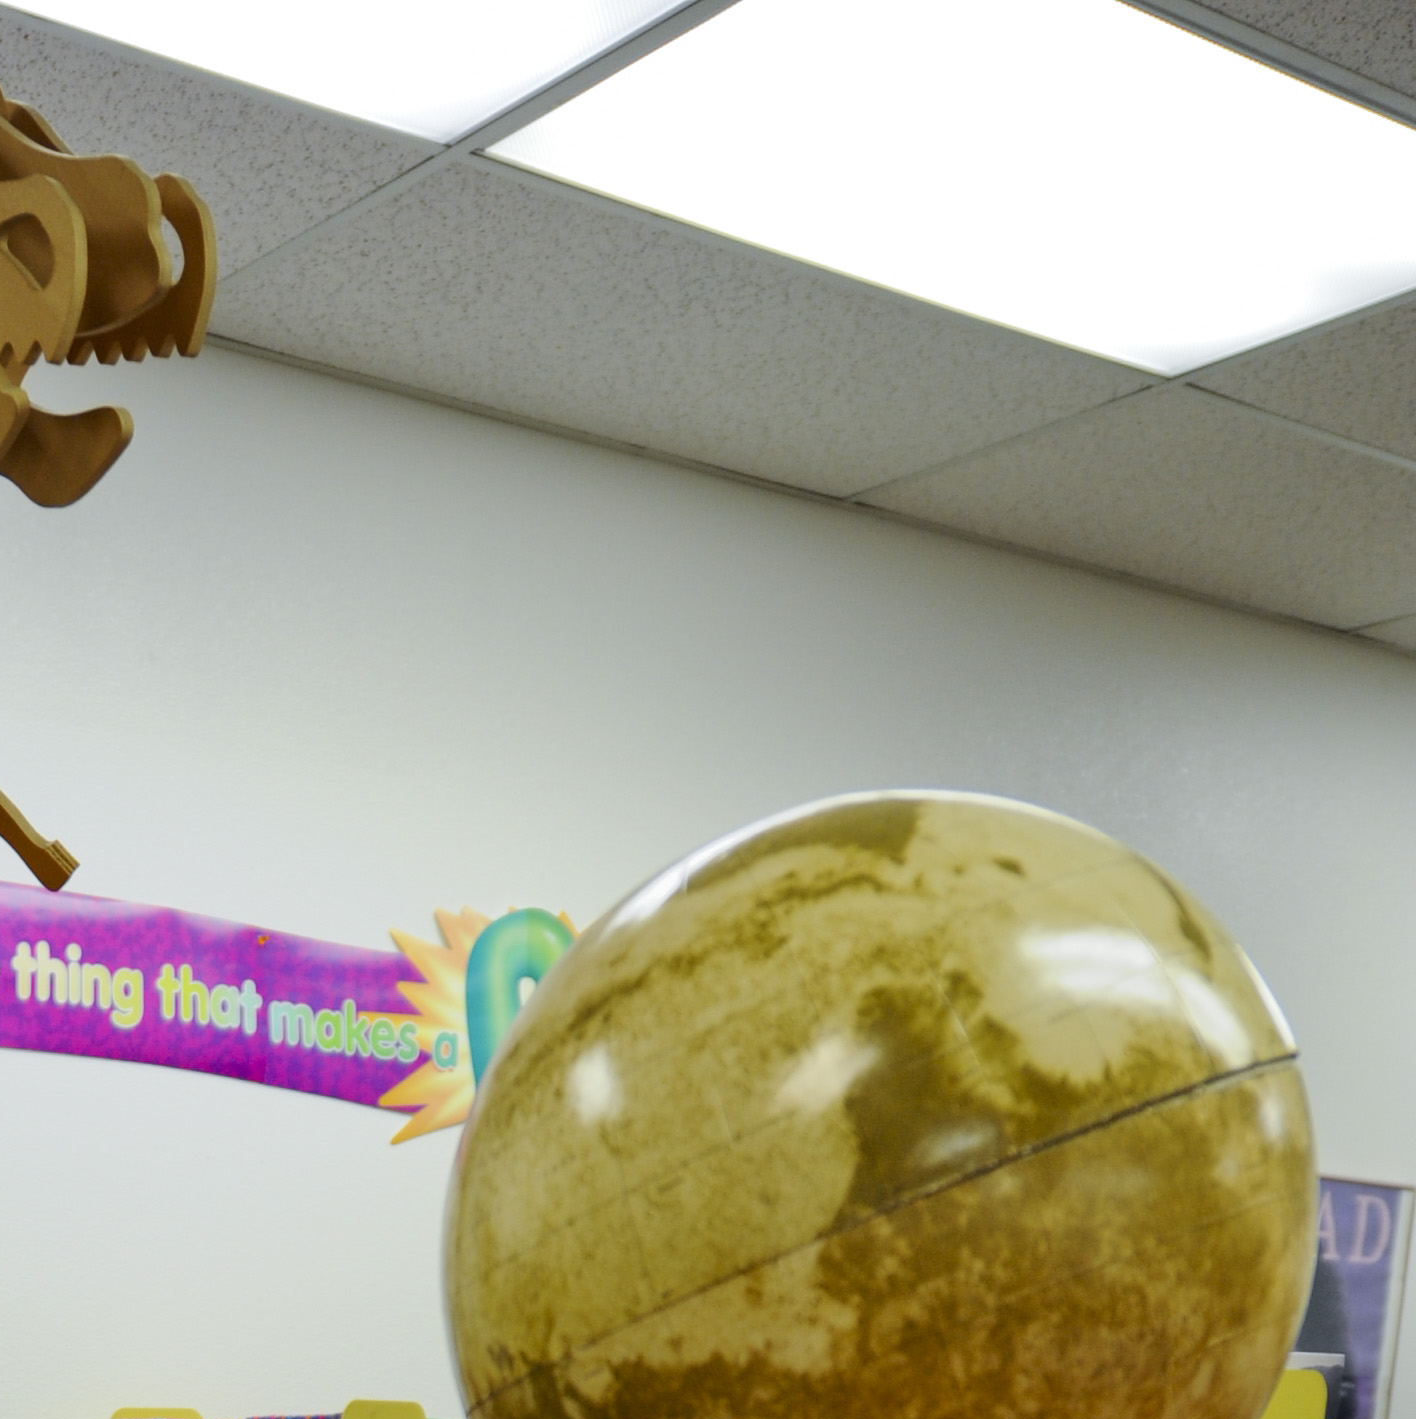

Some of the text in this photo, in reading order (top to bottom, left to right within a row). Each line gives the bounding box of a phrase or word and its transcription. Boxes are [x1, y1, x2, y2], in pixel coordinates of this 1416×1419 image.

[12, 940, 145, 1028] thing
[156, 964, 263, 1034] that
[269, 1000, 420, 1062] makes
[433, 1027, 459, 1070] a
[1318, 1191, 1393, 1266] AD
